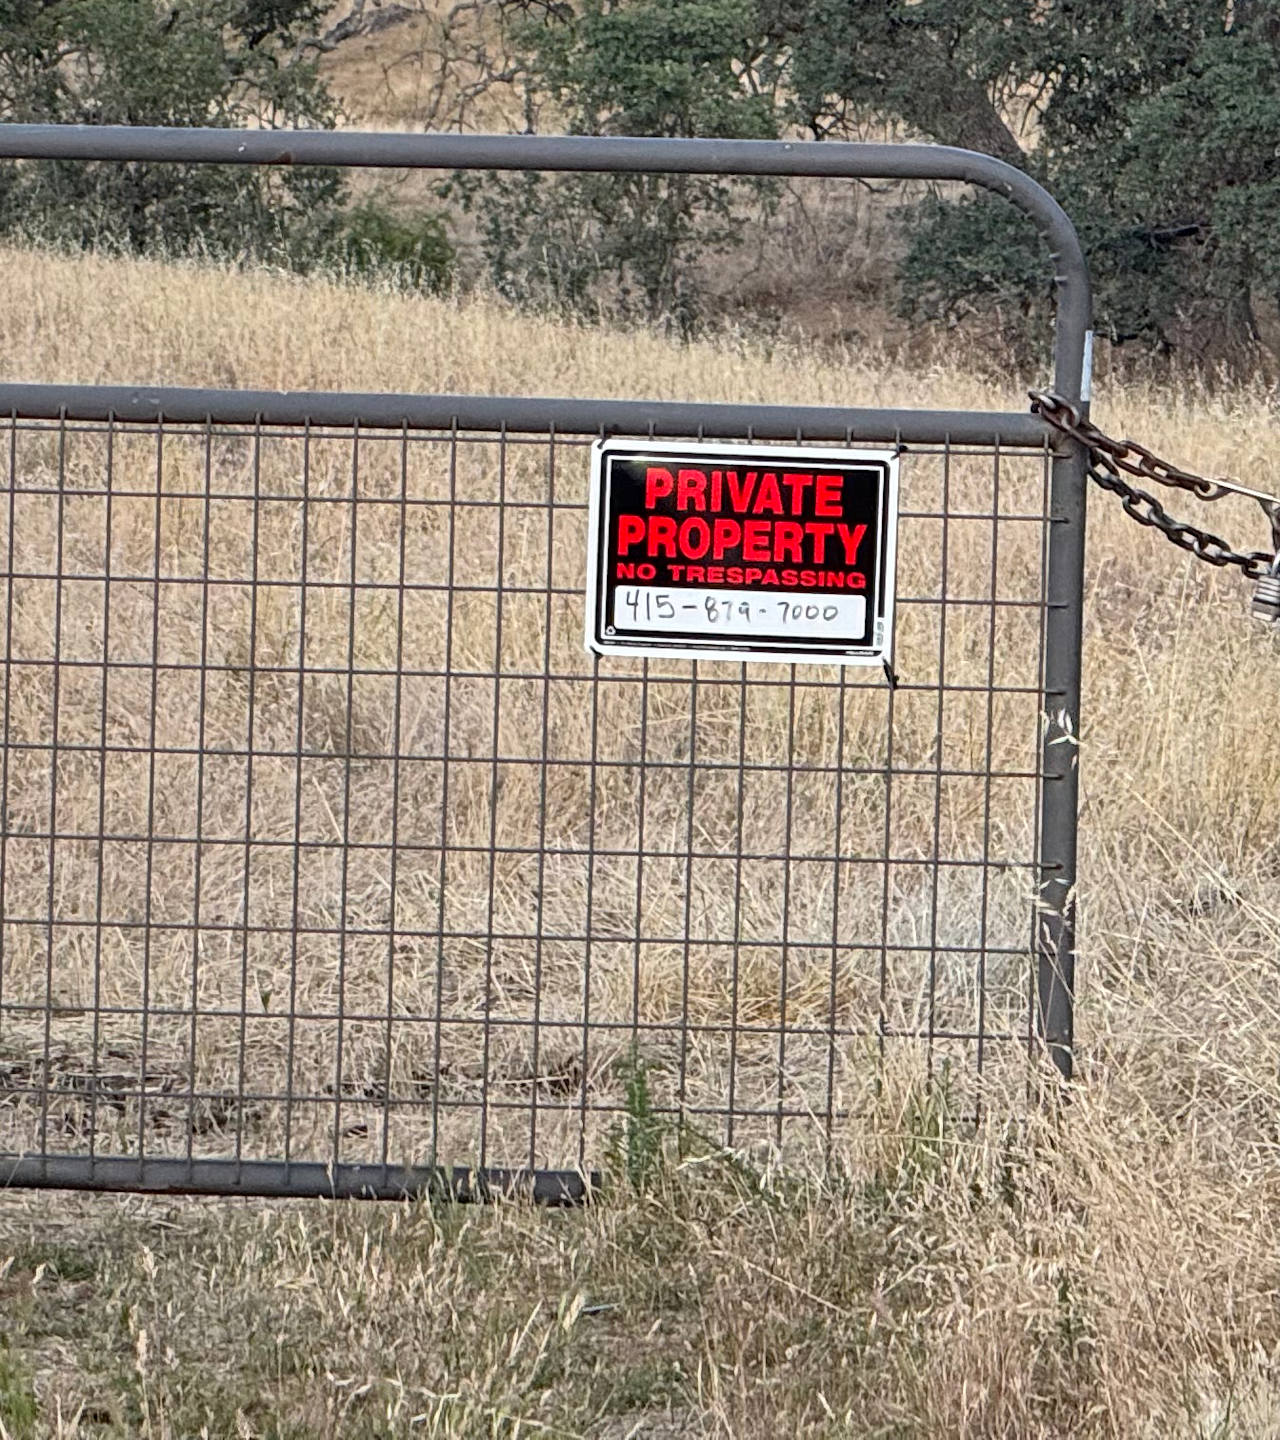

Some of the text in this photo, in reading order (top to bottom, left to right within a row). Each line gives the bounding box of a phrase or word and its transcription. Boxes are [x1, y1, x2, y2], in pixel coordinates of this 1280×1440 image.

[645, 467, 844, 517] PRIVATE
[617, 515, 868, 565] PROPERTY
[616, 562, 867, 589] NO TRESPASSING
[626, 589, 839, 623] 415-879-7000
